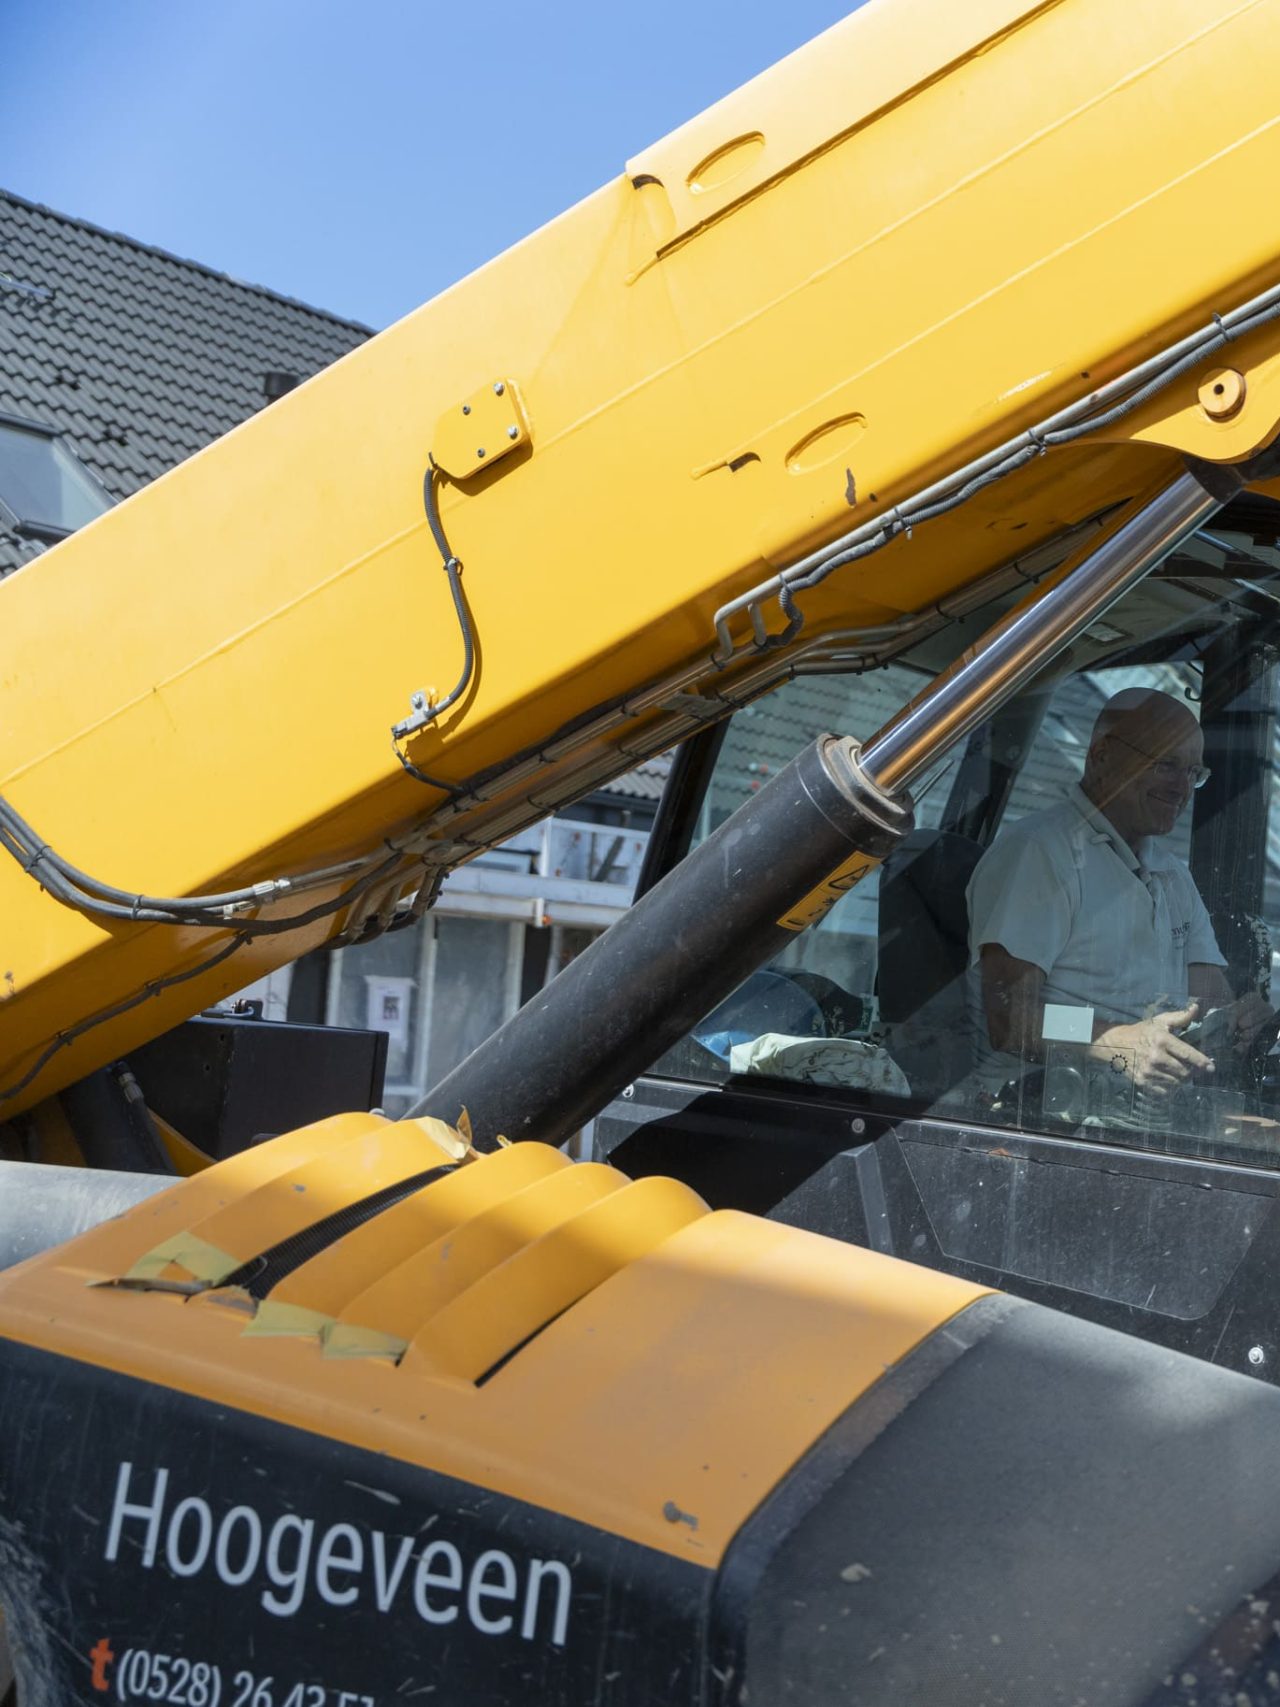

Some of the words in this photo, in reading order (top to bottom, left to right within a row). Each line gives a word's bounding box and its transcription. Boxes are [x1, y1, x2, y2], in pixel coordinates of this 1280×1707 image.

[105, 1461, 571, 1645] Hoogeveen
[91, 1638, 113, 1691] t
[117, 1648, 221, 1707] (0528)
[233, 1670, 273, 1707] 26
